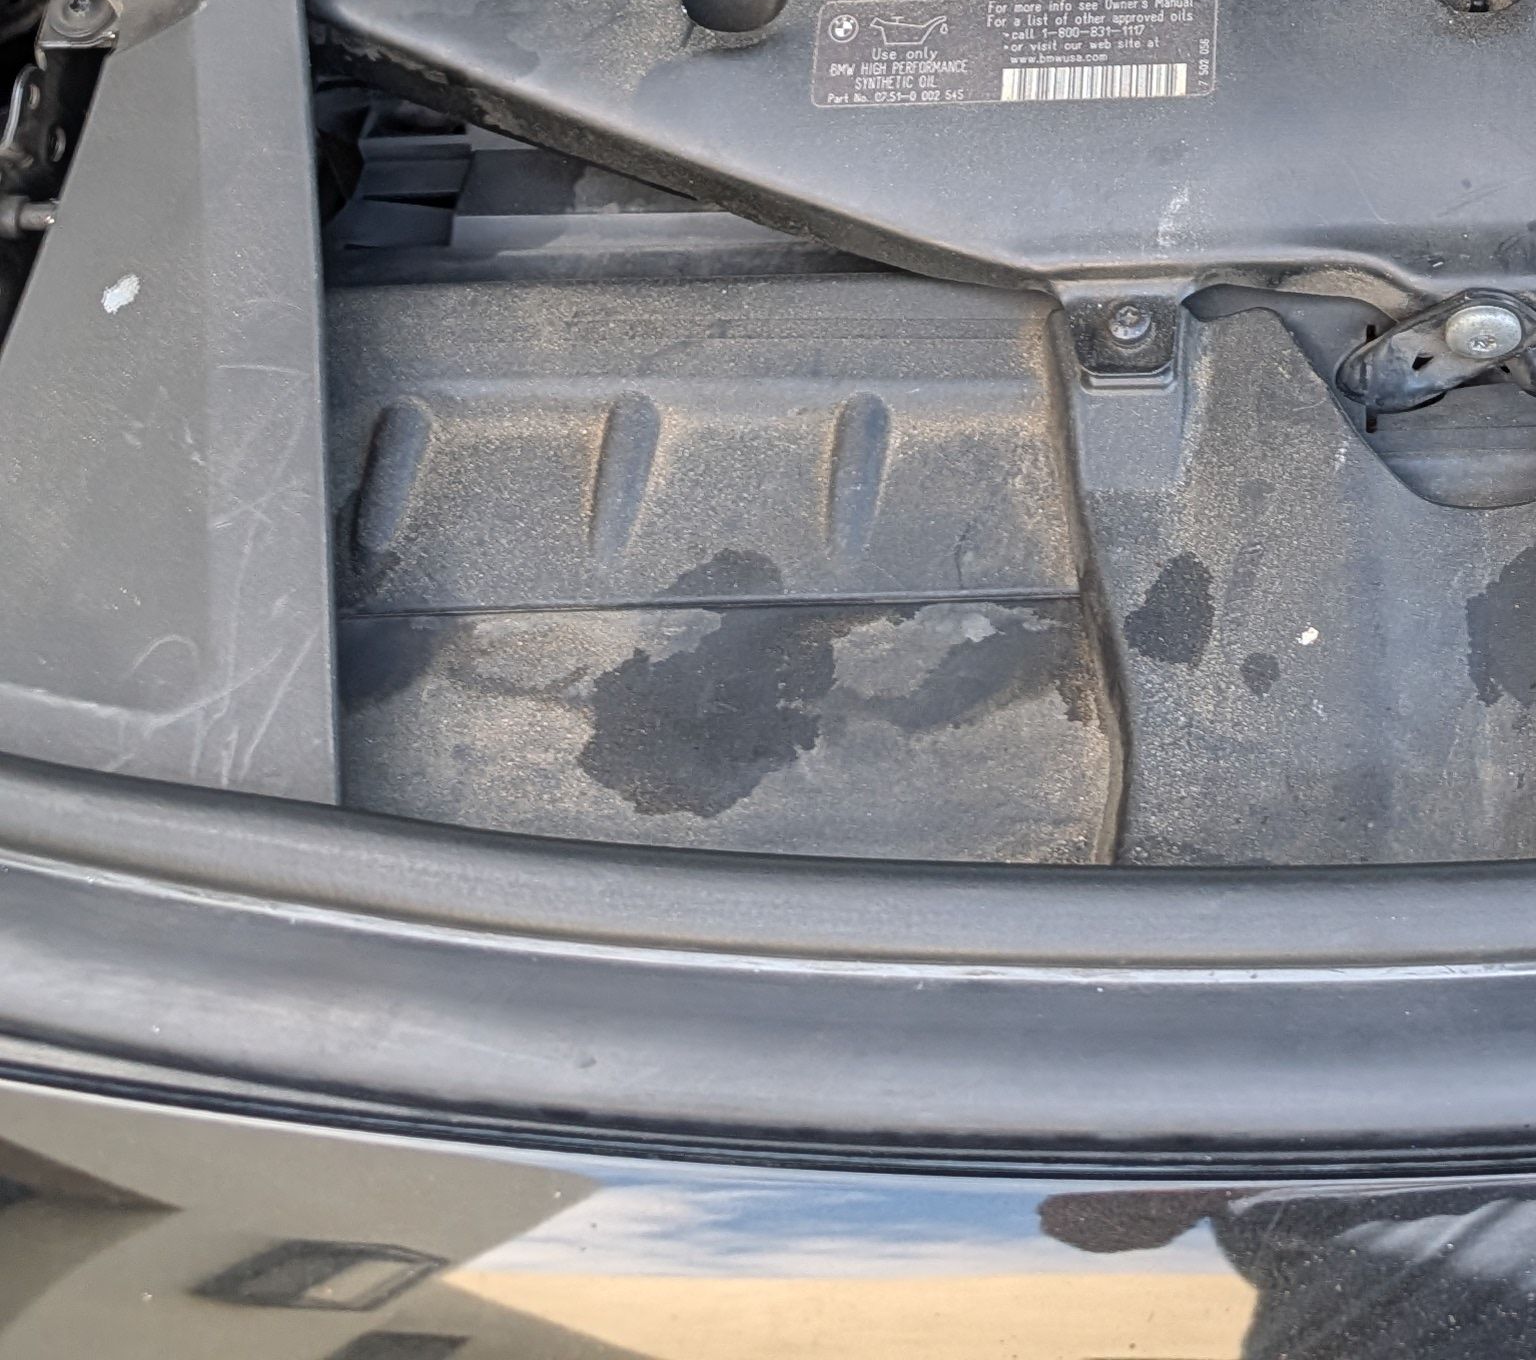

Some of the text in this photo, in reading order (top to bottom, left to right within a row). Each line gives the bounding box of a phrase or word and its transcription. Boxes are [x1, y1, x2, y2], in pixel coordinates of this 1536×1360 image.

[987, 1, 1007, 13] For
[1014, 4, 1042, 13] more
[1049, 0, 1072, 11] info
[1079, 1, 1098, 11] see
[986, 9, 1194, 27] For a list of other approved oils
[1011, 28, 1035, 40] call
[1010, 37, 1160, 52] or visit our web site at
[872, 47, 938, 61] Use only
[1010, 53, 1108, 64] www.bmwusa.com
[830, 59, 968, 77] BMW HIGH PERFORMANCE
[855, 75, 938, 91] SYNTHETIC OIL
[828, 93, 849, 103] Part
